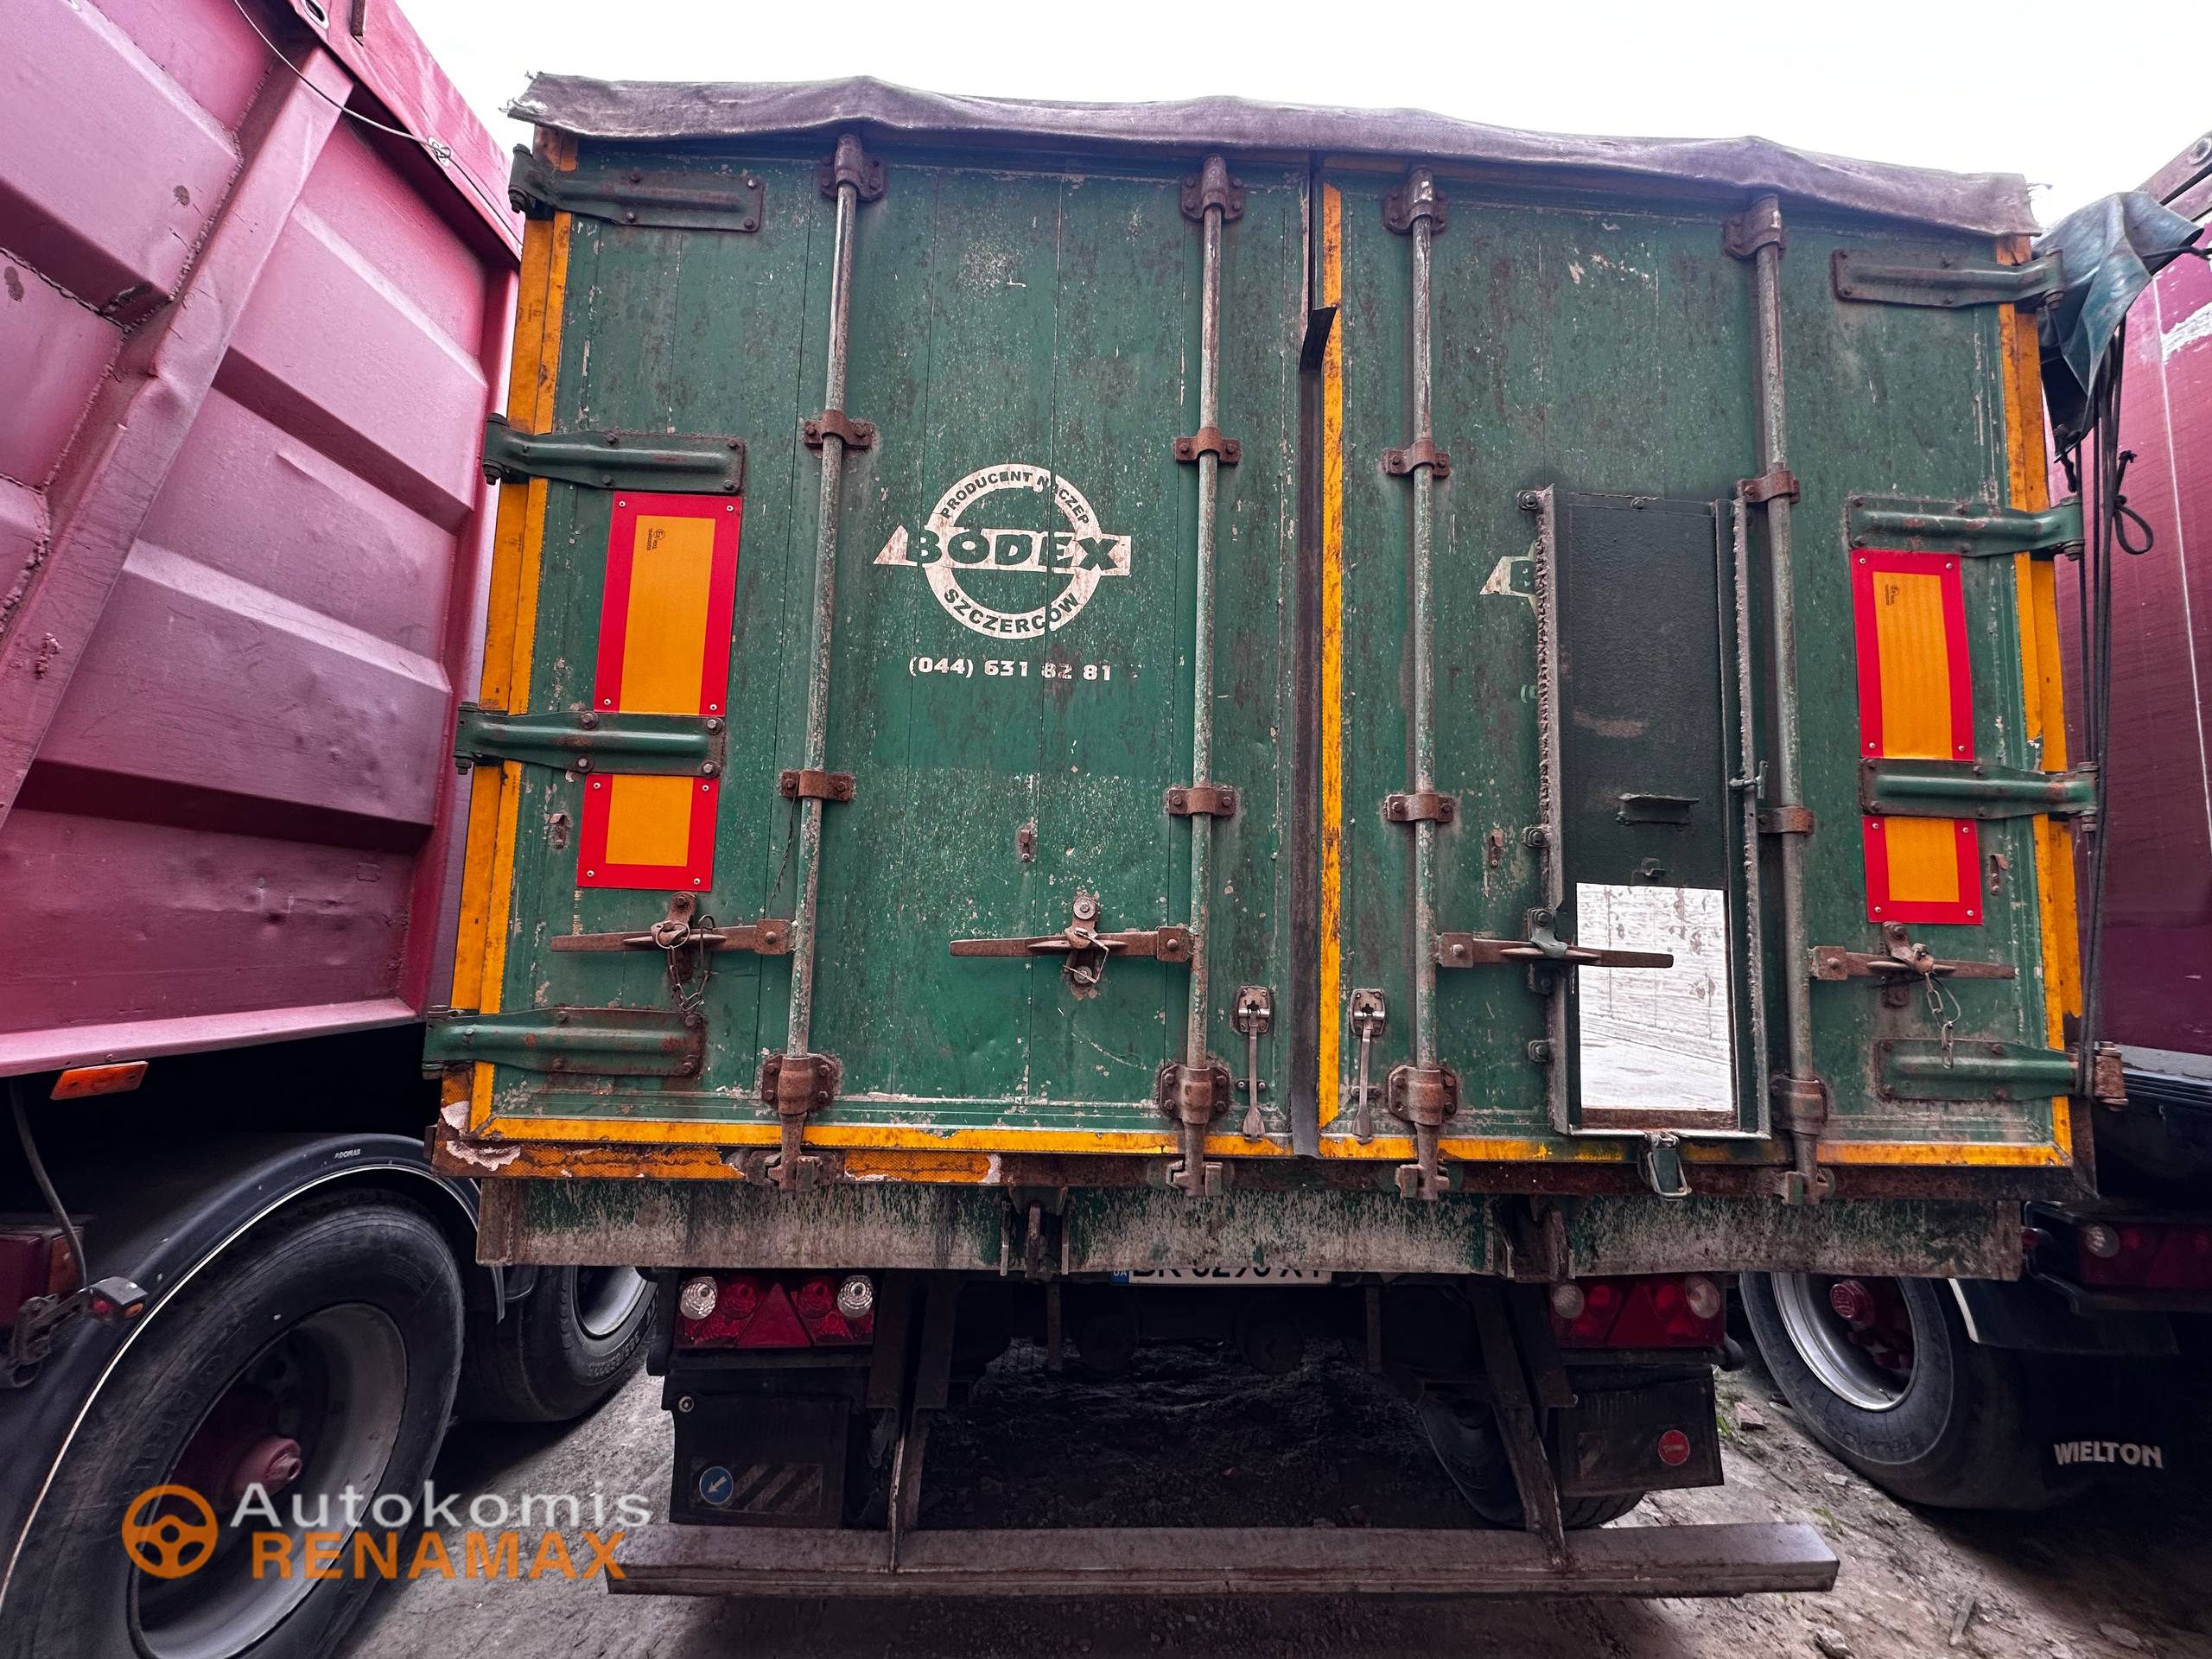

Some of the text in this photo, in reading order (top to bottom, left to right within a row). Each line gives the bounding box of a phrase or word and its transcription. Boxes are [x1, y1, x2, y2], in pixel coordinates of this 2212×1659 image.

[941, 471, 1033, 519] PRODUCENT
[906, 527, 1121, 572] BODEX
[908, 656, 975, 678] (044)
[984, 659, 1029, 677] 631
[1083, 664, 1111, 681] 81
[2053, 1440, 2164, 1469] WIELTON
